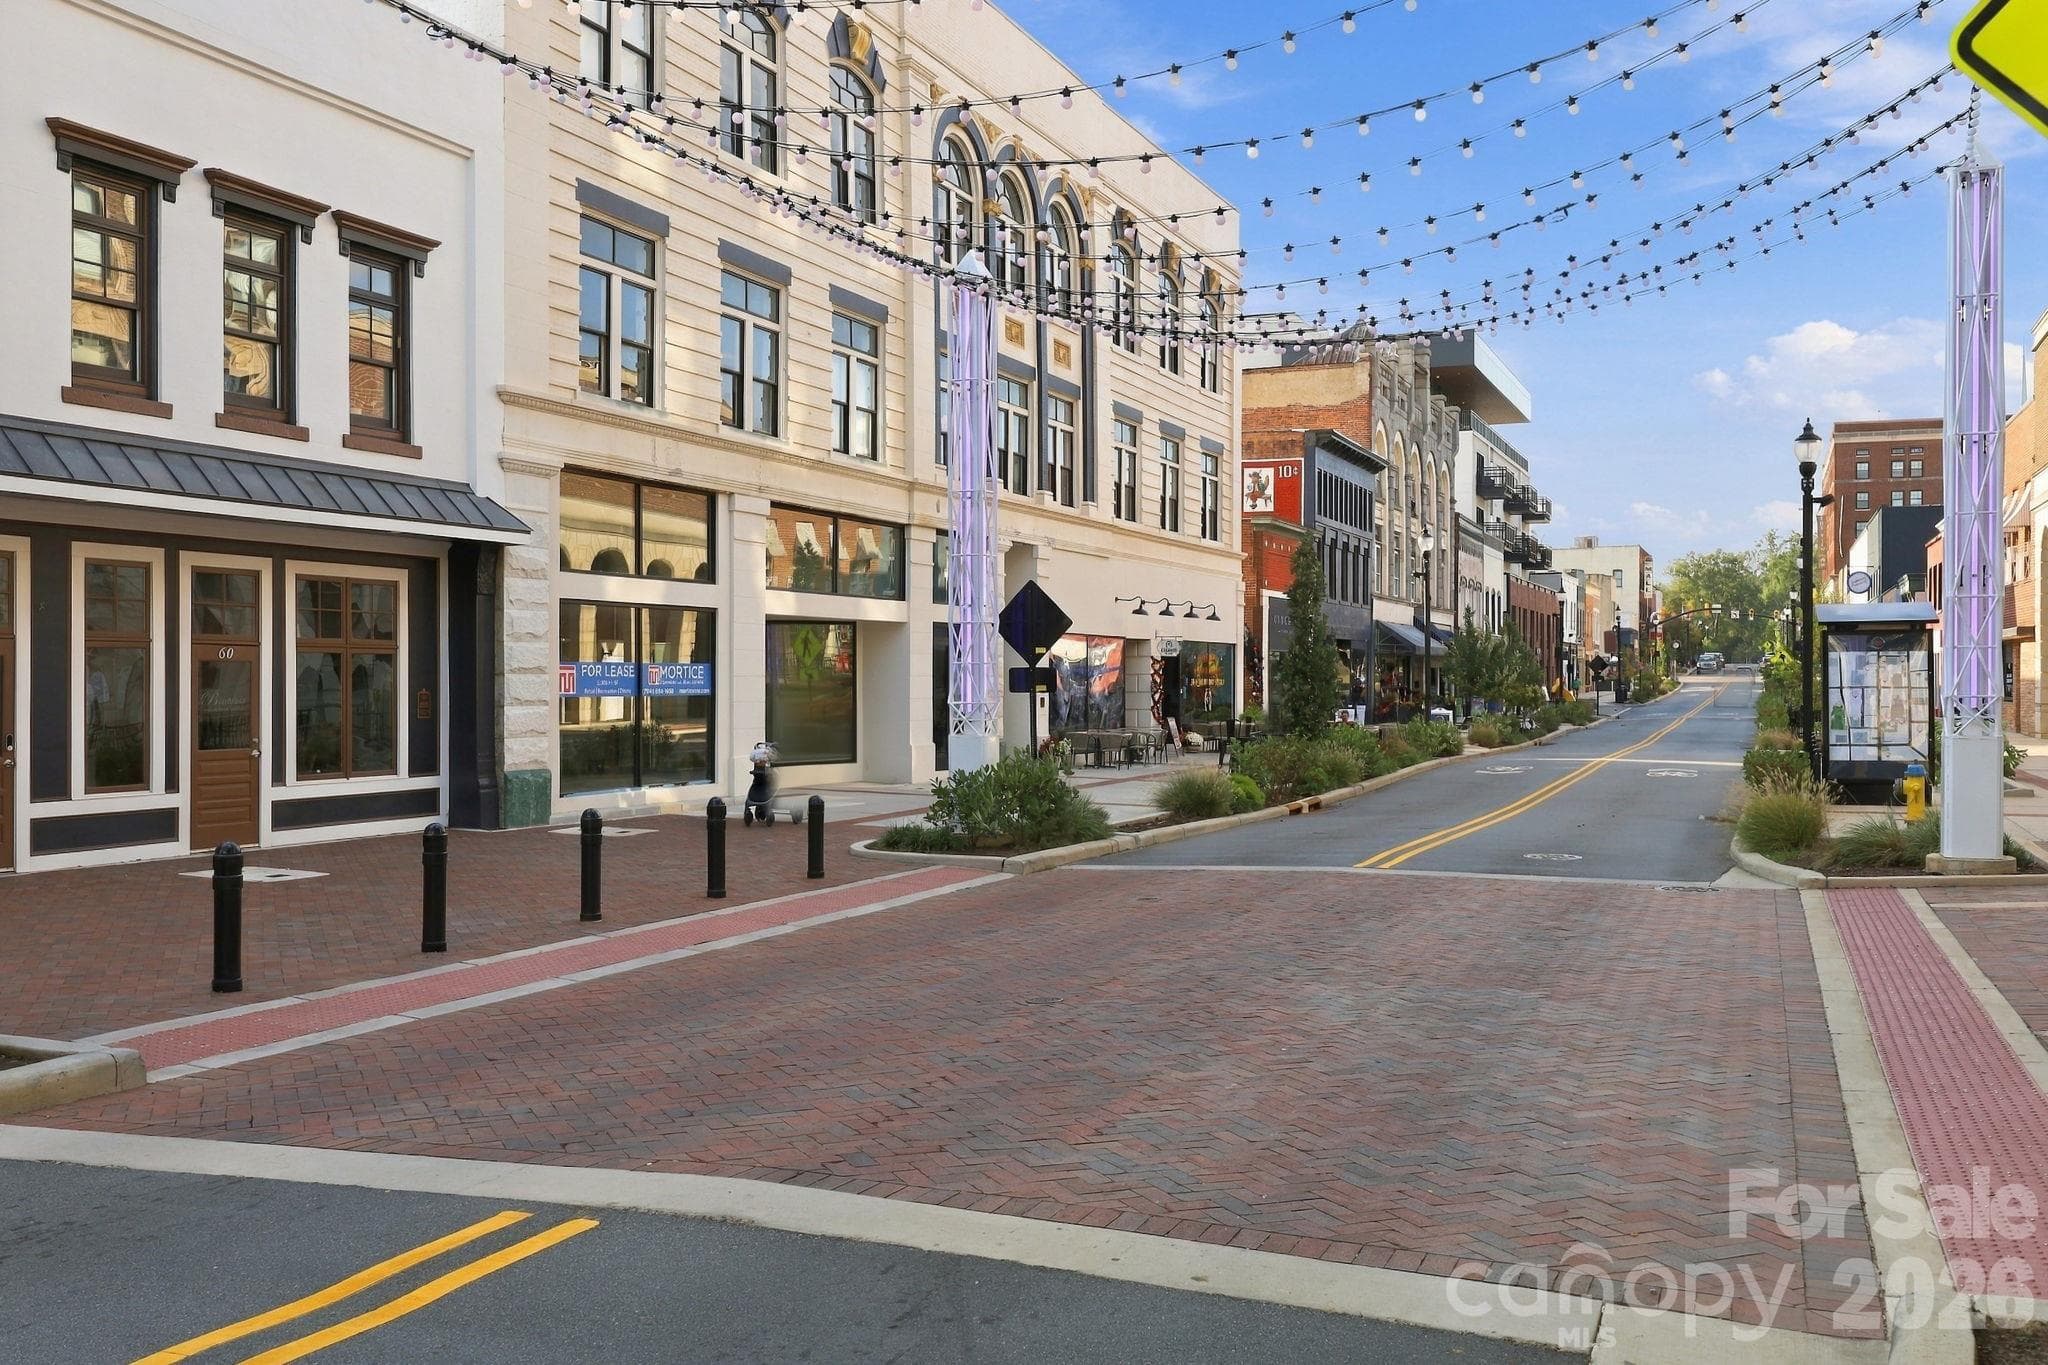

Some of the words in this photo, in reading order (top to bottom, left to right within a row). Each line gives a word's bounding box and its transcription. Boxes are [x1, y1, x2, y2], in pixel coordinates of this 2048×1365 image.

[218, 647, 234, 660] 60
[581, 664, 601, 677] FOR
[605, 665, 635, 677] LEASE
[660, 665, 704, 679] MORTICE
